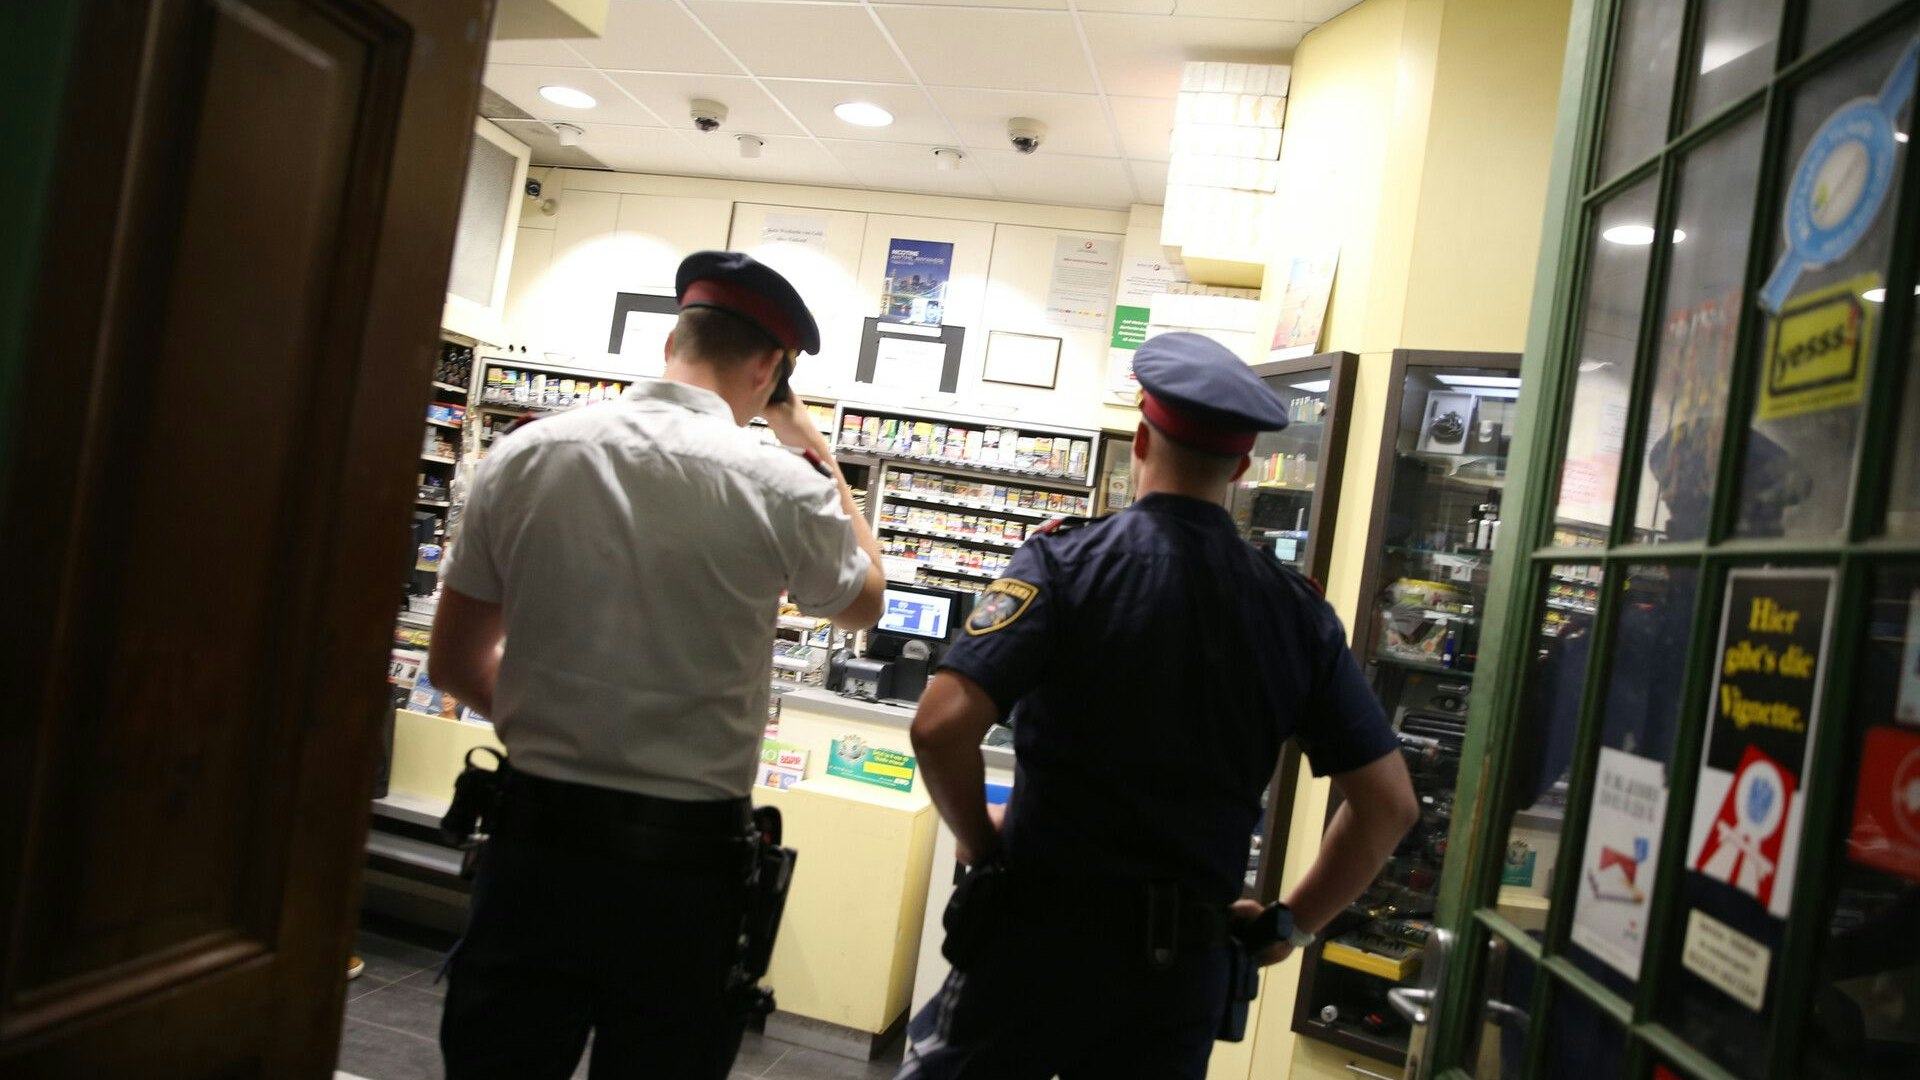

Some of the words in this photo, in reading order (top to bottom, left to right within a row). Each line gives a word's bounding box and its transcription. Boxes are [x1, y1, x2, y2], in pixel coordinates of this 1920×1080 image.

[1749, 597, 1799, 633] Hier
[1723, 640, 1777, 677] gibt's
[1779, 644, 1815, 679] die
[1720, 684, 1805, 733] Vignette.
